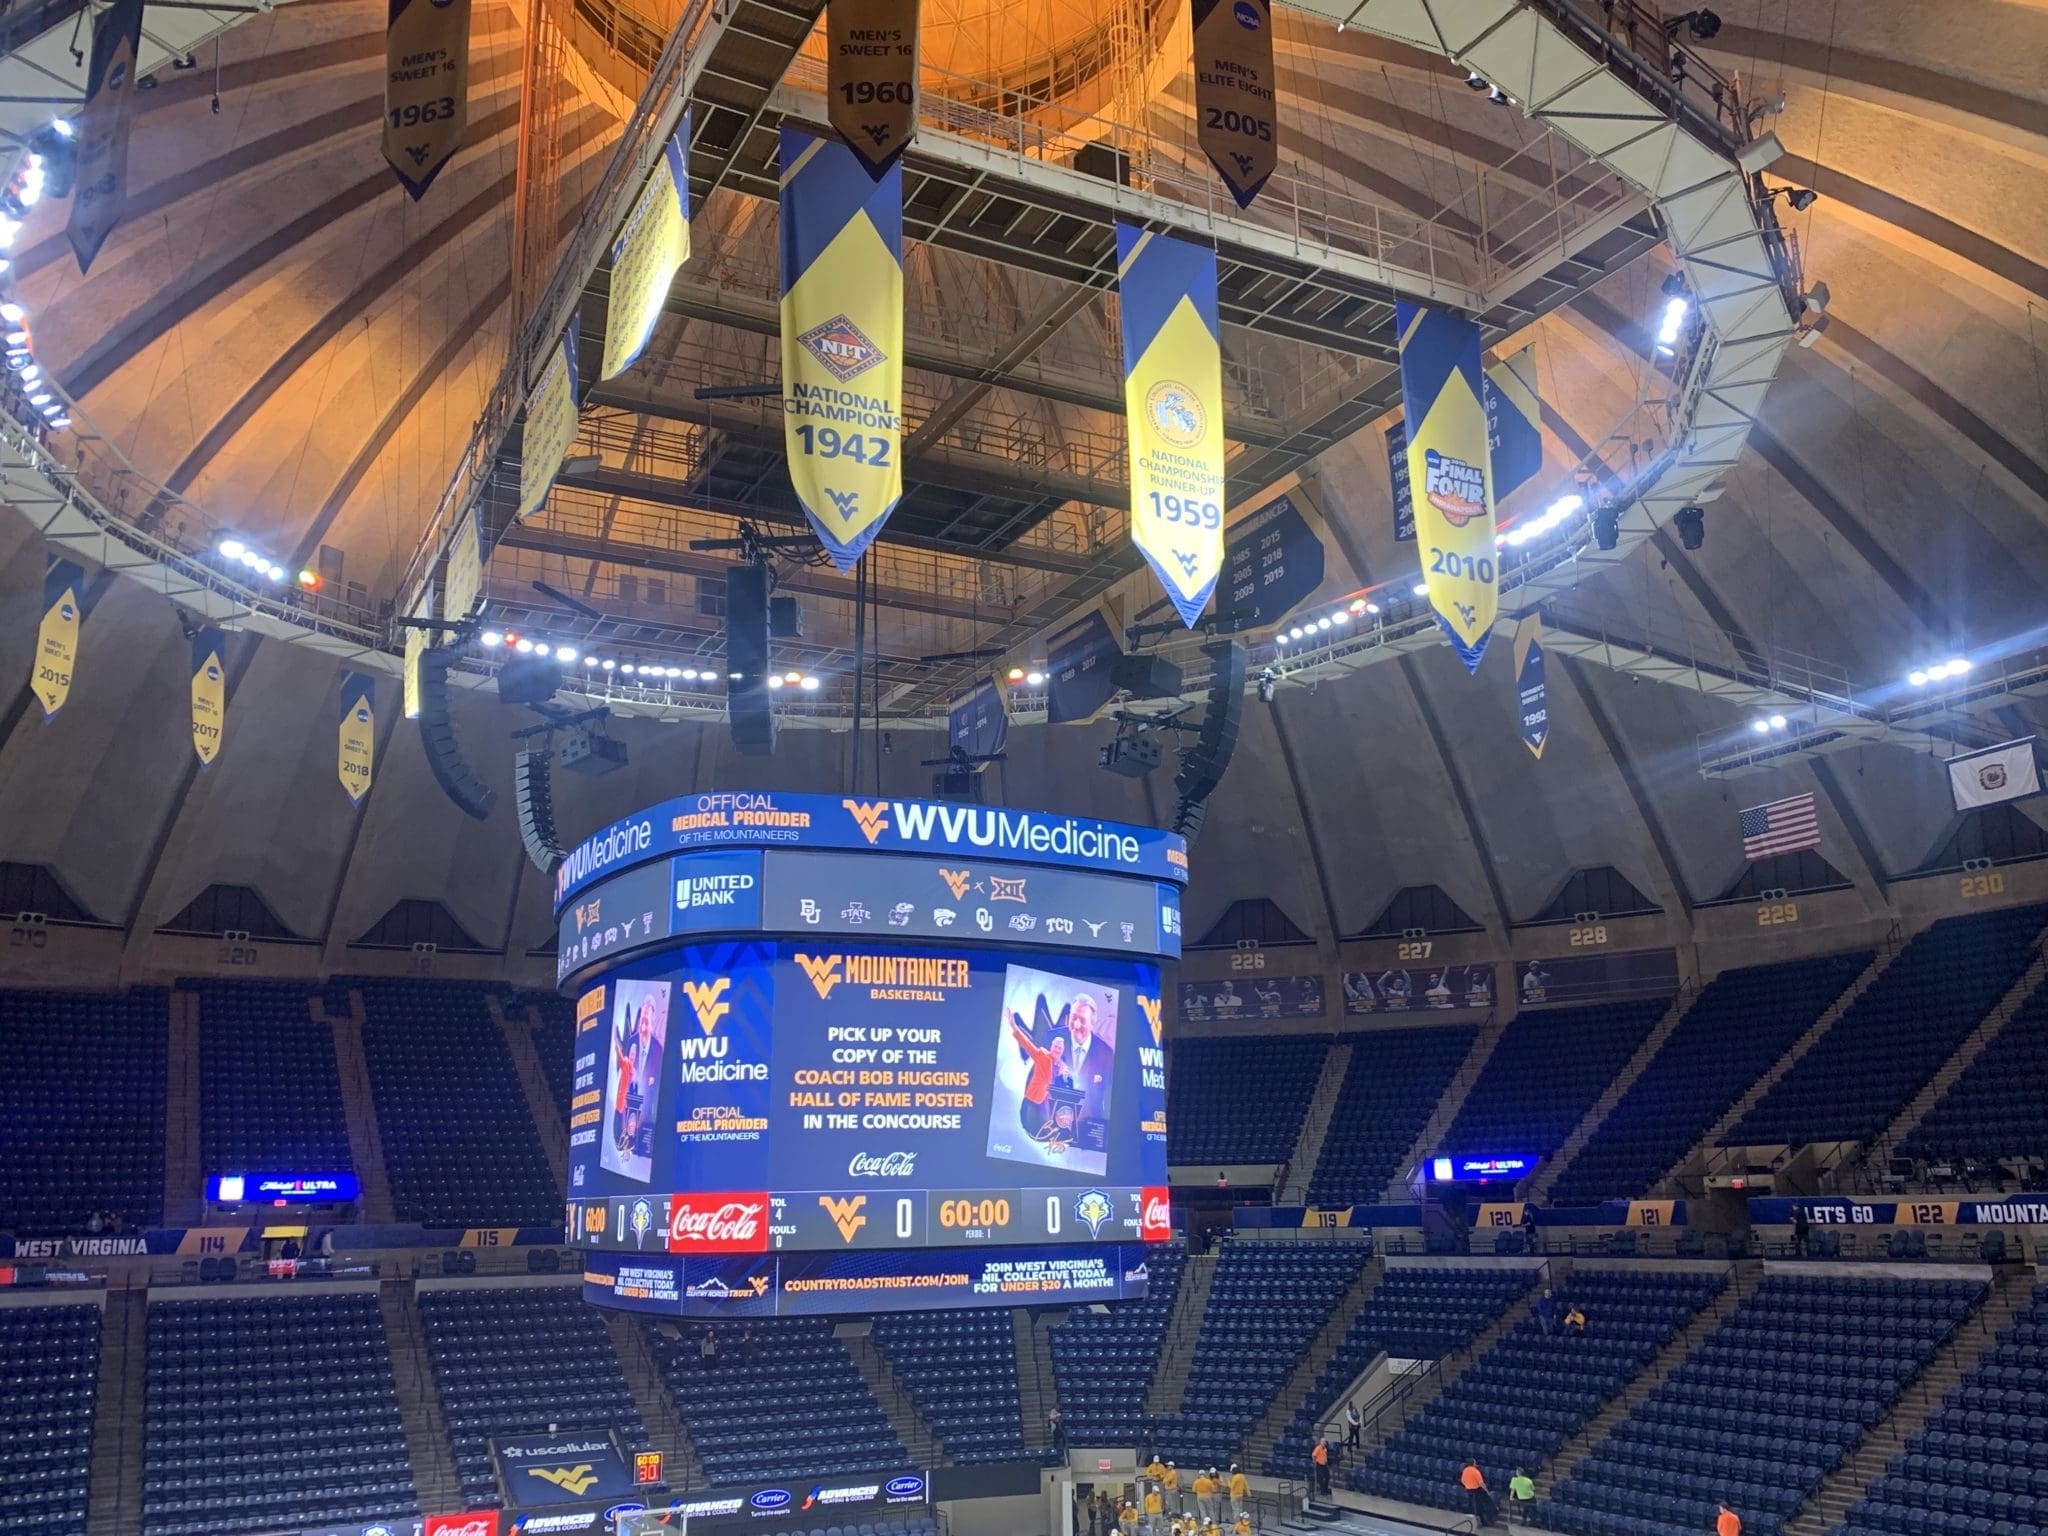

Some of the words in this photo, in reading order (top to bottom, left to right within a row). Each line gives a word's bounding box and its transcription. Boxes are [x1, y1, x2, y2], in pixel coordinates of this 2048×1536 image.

[849, 29, 902, 42] MEN'S
[402, 48, 447, 67] MEN'S
[840, 44, 890, 57] SWEET
[896, 45, 913, 56] 16
[390, 65, 438, 83] SWEET
[443, 59, 456, 73] 16
[1215, 59, 1258, 81] MEN'S
[840, 81, 914, 105] 1960
[1200, 72, 1235, 88] ELITE
[1238, 79, 1273, 101] EIGHT
[390, 96, 456, 129] 1963
[1206, 107, 1271, 143] 2005
[821, 338, 867, 360] NIT
[793, 382, 894, 413] NATIONAL
[784, 398, 901, 432] CHAMPIONS
[795, 424, 891, 467] 1942
[1152, 449, 1209, 471] NATIONAL
[1139, 457, 1224, 485] CHAMPIONSHIP
[1440, 458, 1482, 484] FINAL
[1150, 474, 1215, 497] RUNNER-UP
[1427, 467, 1484, 504] FOUR
[1149, 491, 1221, 530] 1959
[1431, 547, 1494, 584] 2010
[40, 666, 69, 687] 2015
[1523, 709, 1548, 727] 1992
[193, 722, 219, 739] 2017
[343, 761, 369, 777] 2018
[698, 794, 778, 812] OFFICIAL
[672, 812, 729, 832] MEDICAL
[733, 811, 811, 828] PROVIDER
[679, 832, 690, 844] OF
[692, 832, 712, 843] THE
[713, 829, 799, 841] MOUNTAINEERS
[692, 875, 754, 891] UNITED
[1960, 875, 2005, 898] 230
[692, 890, 735, 907] BANK
[1757, 903, 1799, 926] 229
[1046, 917, 1073, 934] TCU
[1570, 926, 1607, 946] 228
[1399, 942, 1432, 961] 227
[1231, 953, 1265, 970] 226
[846, 955, 970, 988] MOUNTAINEER
[870, 989, 945, 1002] BASKETBALL
[828, 1027, 866, 1043] PICK
[871, 1027, 893, 1043] UP
[896, 1027, 941, 1043] YOUR
[681, 1037, 728, 1060] WVU
[832, 1049, 878, 1064] COPY
[882, 1049, 903, 1064] OF
[907, 1049, 937, 1064] THE
[682, 1060, 769, 1083] Medicine
[794, 1070, 855, 1086] COACH
[859, 1070, 893, 1086] BOB
[898, 1070, 970, 1086] HUGGINS
[790, 1092, 834, 1108] HALL
[839, 1092, 860, 1108] OF
[865, 1092, 911, 1108] FAME
[915, 1092, 973, 1108] POSTER
[692, 1106, 745, 1120] OFFICIAL
[804, 1114, 822, 1129] IN
[827, 1114, 858, 1129] THE
[862, 1114, 961, 1129] CONCOURSE
[677, 1119, 712, 1133] MEDICAL
[714, 1118, 768, 1131] PROVIDER
[702, 1132, 760, 1142] MOUNTAINEERS
[849, 1151, 918, 1177] Coca-Cola
[770, 1198, 787, 1207] TOL
[672, 1203, 763, 1241] Coca-Cola
[776, 1211, 782, 1221] 4
[897, 1199, 912, 1238] 0
[940, 1199, 1010, 1227] 60:00
[1047, 1196, 1061, 1234] 0
[1318, 1212, 1337, 1227] 119
[1489, 1211, 1513, 1226] 120
[1640, 1208, 1659, 1225] 121
[1804, 1206, 1846, 1223] LET'S
[1852, 1206, 1873, 1223] GO
[1911, 1205, 1943, 1223] 122
[477, 1231, 498, 1246] 115
[769, 1225, 796, 1235] FOULS
[15, 1240, 63, 1257] WEST
[71, 1239, 148, 1255] VIRGINIA
[200, 1235, 224, 1253] 114
[776, 1236, 782, 1248] 0
[985, 1263, 1013, 1273] JOIN
[1015, 1261, 1047, 1272] WEST
[1049, 1259, 1104, 1270] VIRGINIA'S
[784, 1274, 969, 1292] COUNTRYROADSTRUST.COM/JOIN
[982, 1273, 1003, 1283] NIL
[1005, 1270, 1069, 1282] COLLECTIVE
[1071, 1268, 1107, 1279] TODAY
[974, 1283, 998, 1294] FOR
[1001, 1281, 1039, 1292] UNDER
[1041, 1279, 1061, 1291] $20
[1063, 1279, 1072, 1289] A
[1073, 1277, 1114, 1288] MONTH!
[637, 1454, 660, 1466] 60:00
[638, 1465, 657, 1482] 30
[817, 1485, 879, 1500] ADVANCED
[890, 1480, 919, 1491] Carrier
[679, 1499, 743, 1512] ADVANCED
[756, 1492, 788, 1504] Carrier
[523, 1513, 596, 1530] ADVANCED
